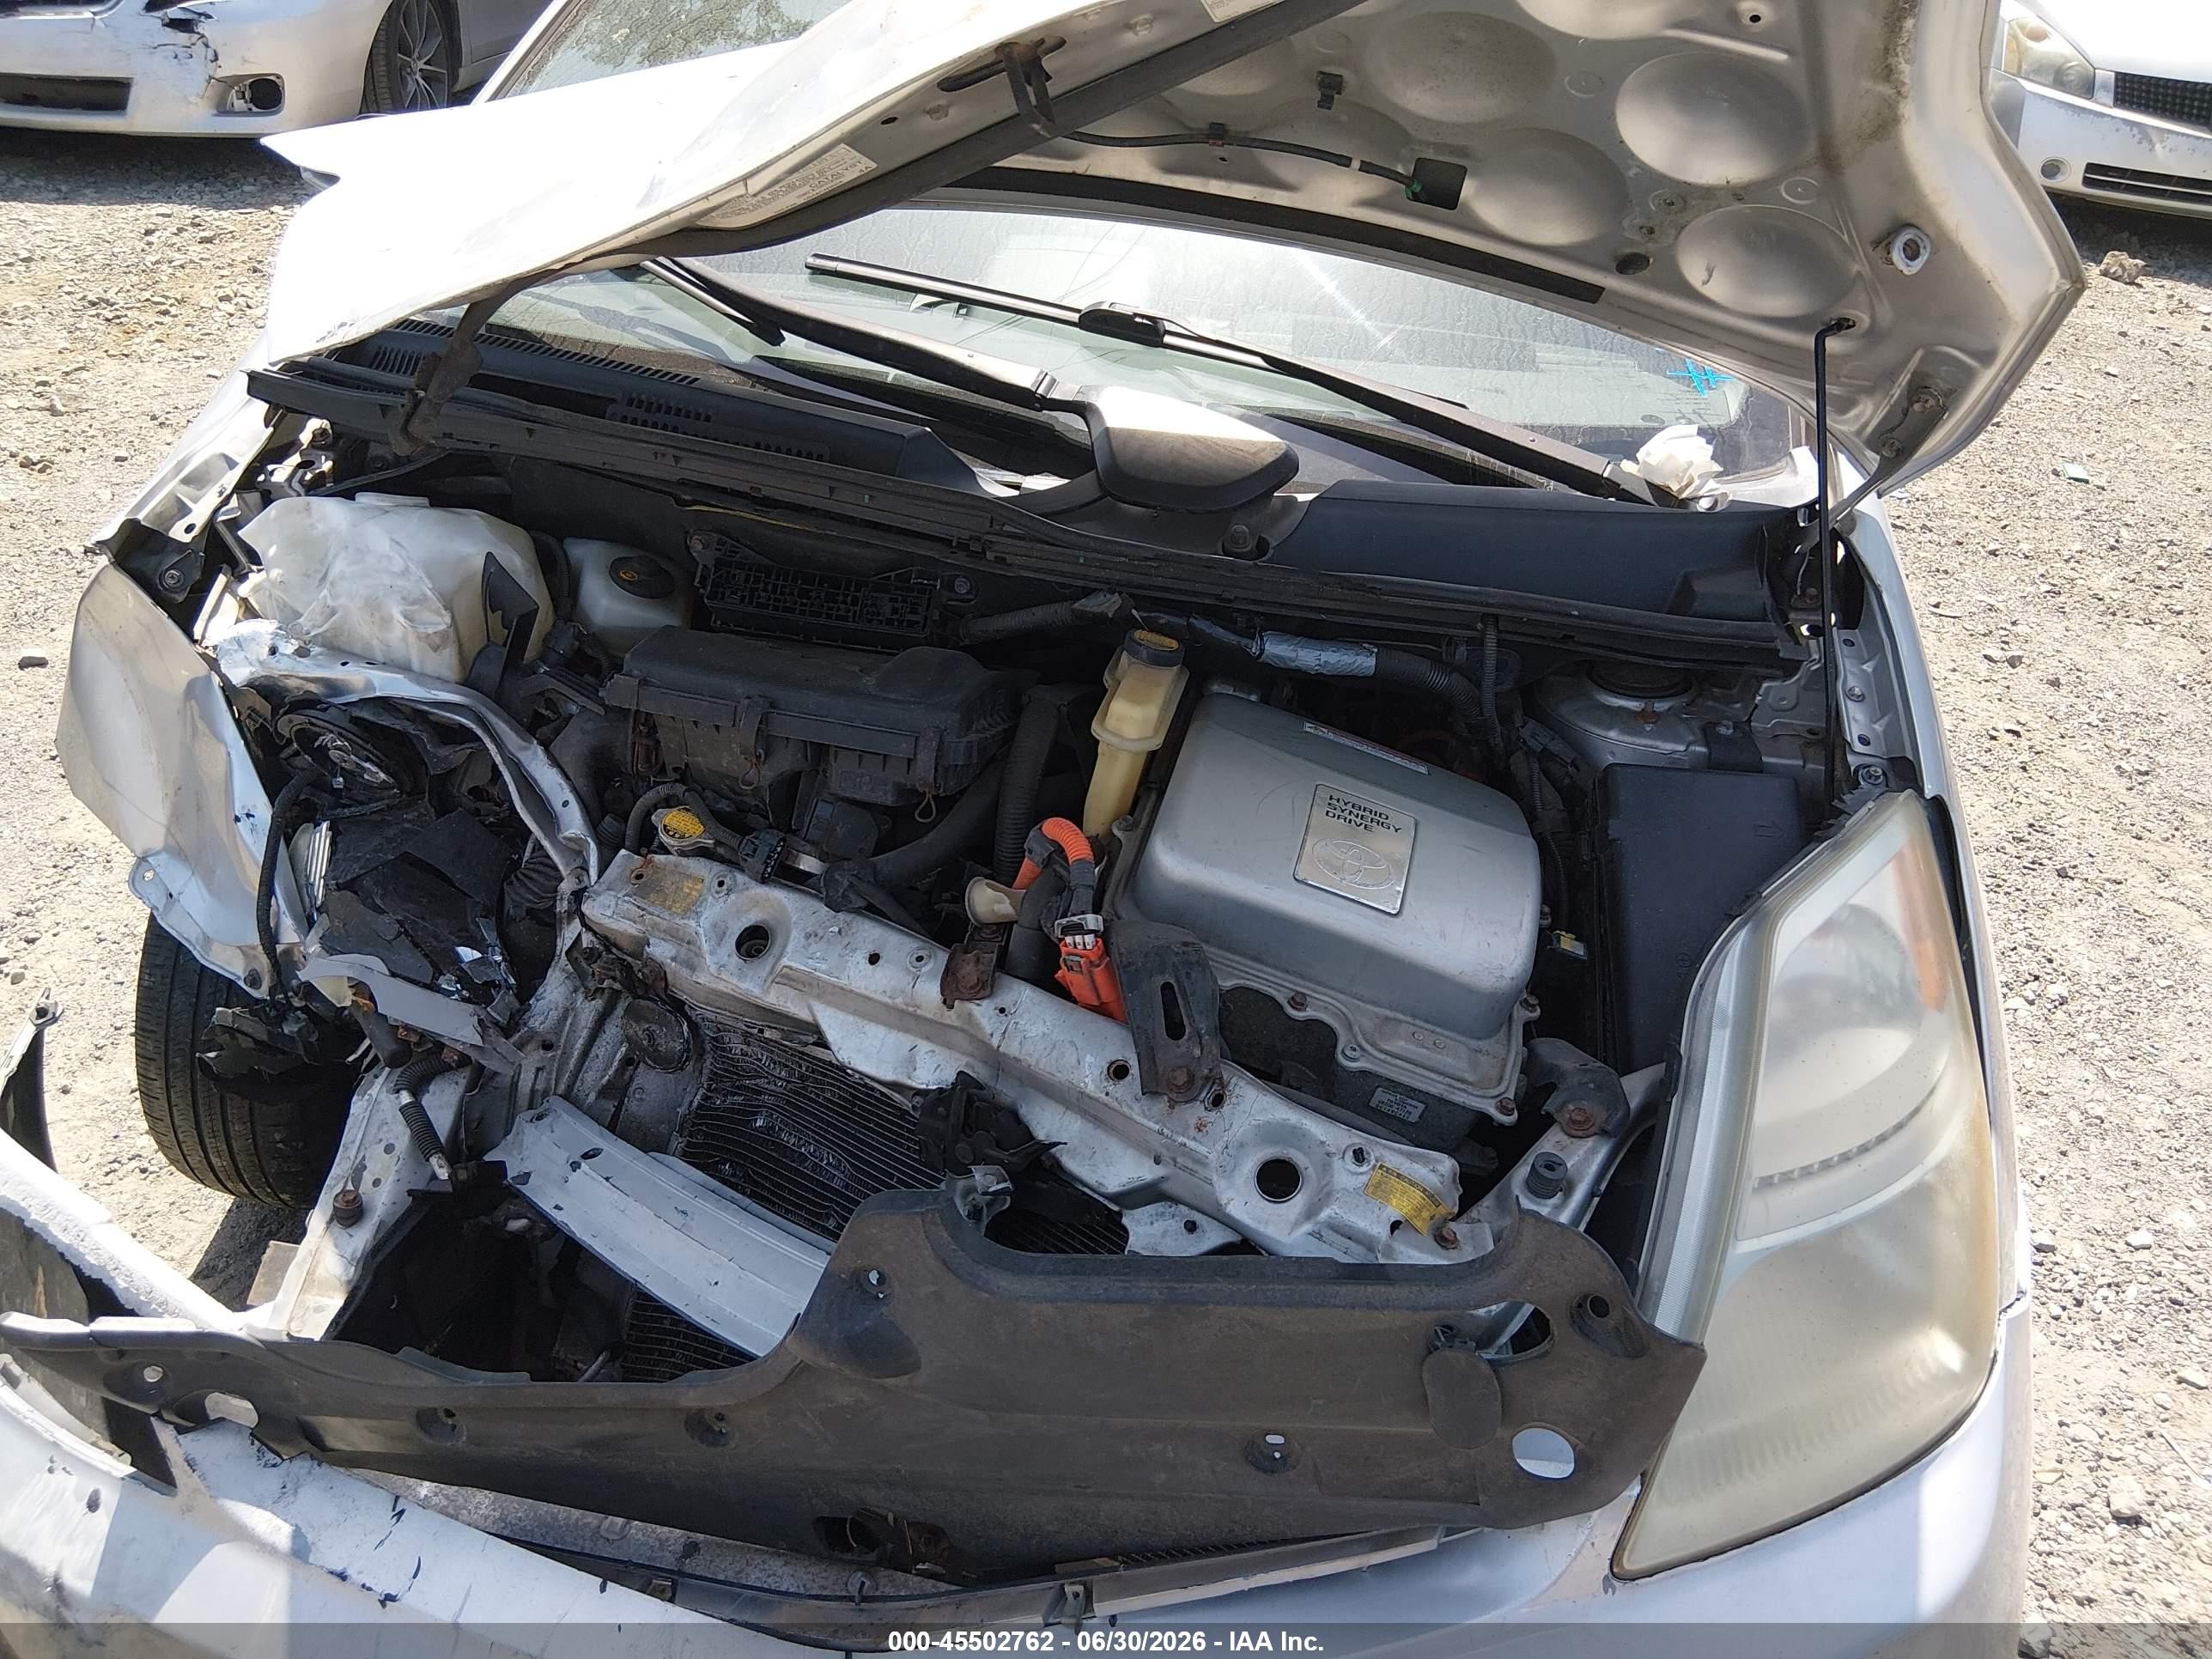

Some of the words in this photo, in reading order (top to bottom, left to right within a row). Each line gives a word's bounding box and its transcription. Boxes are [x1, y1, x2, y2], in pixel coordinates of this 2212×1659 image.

[1327, 802, 1401, 833] SYNERGY
[1328, 794, 1389, 820] HYBRID
[1325, 810, 1374, 832] DRIVE
